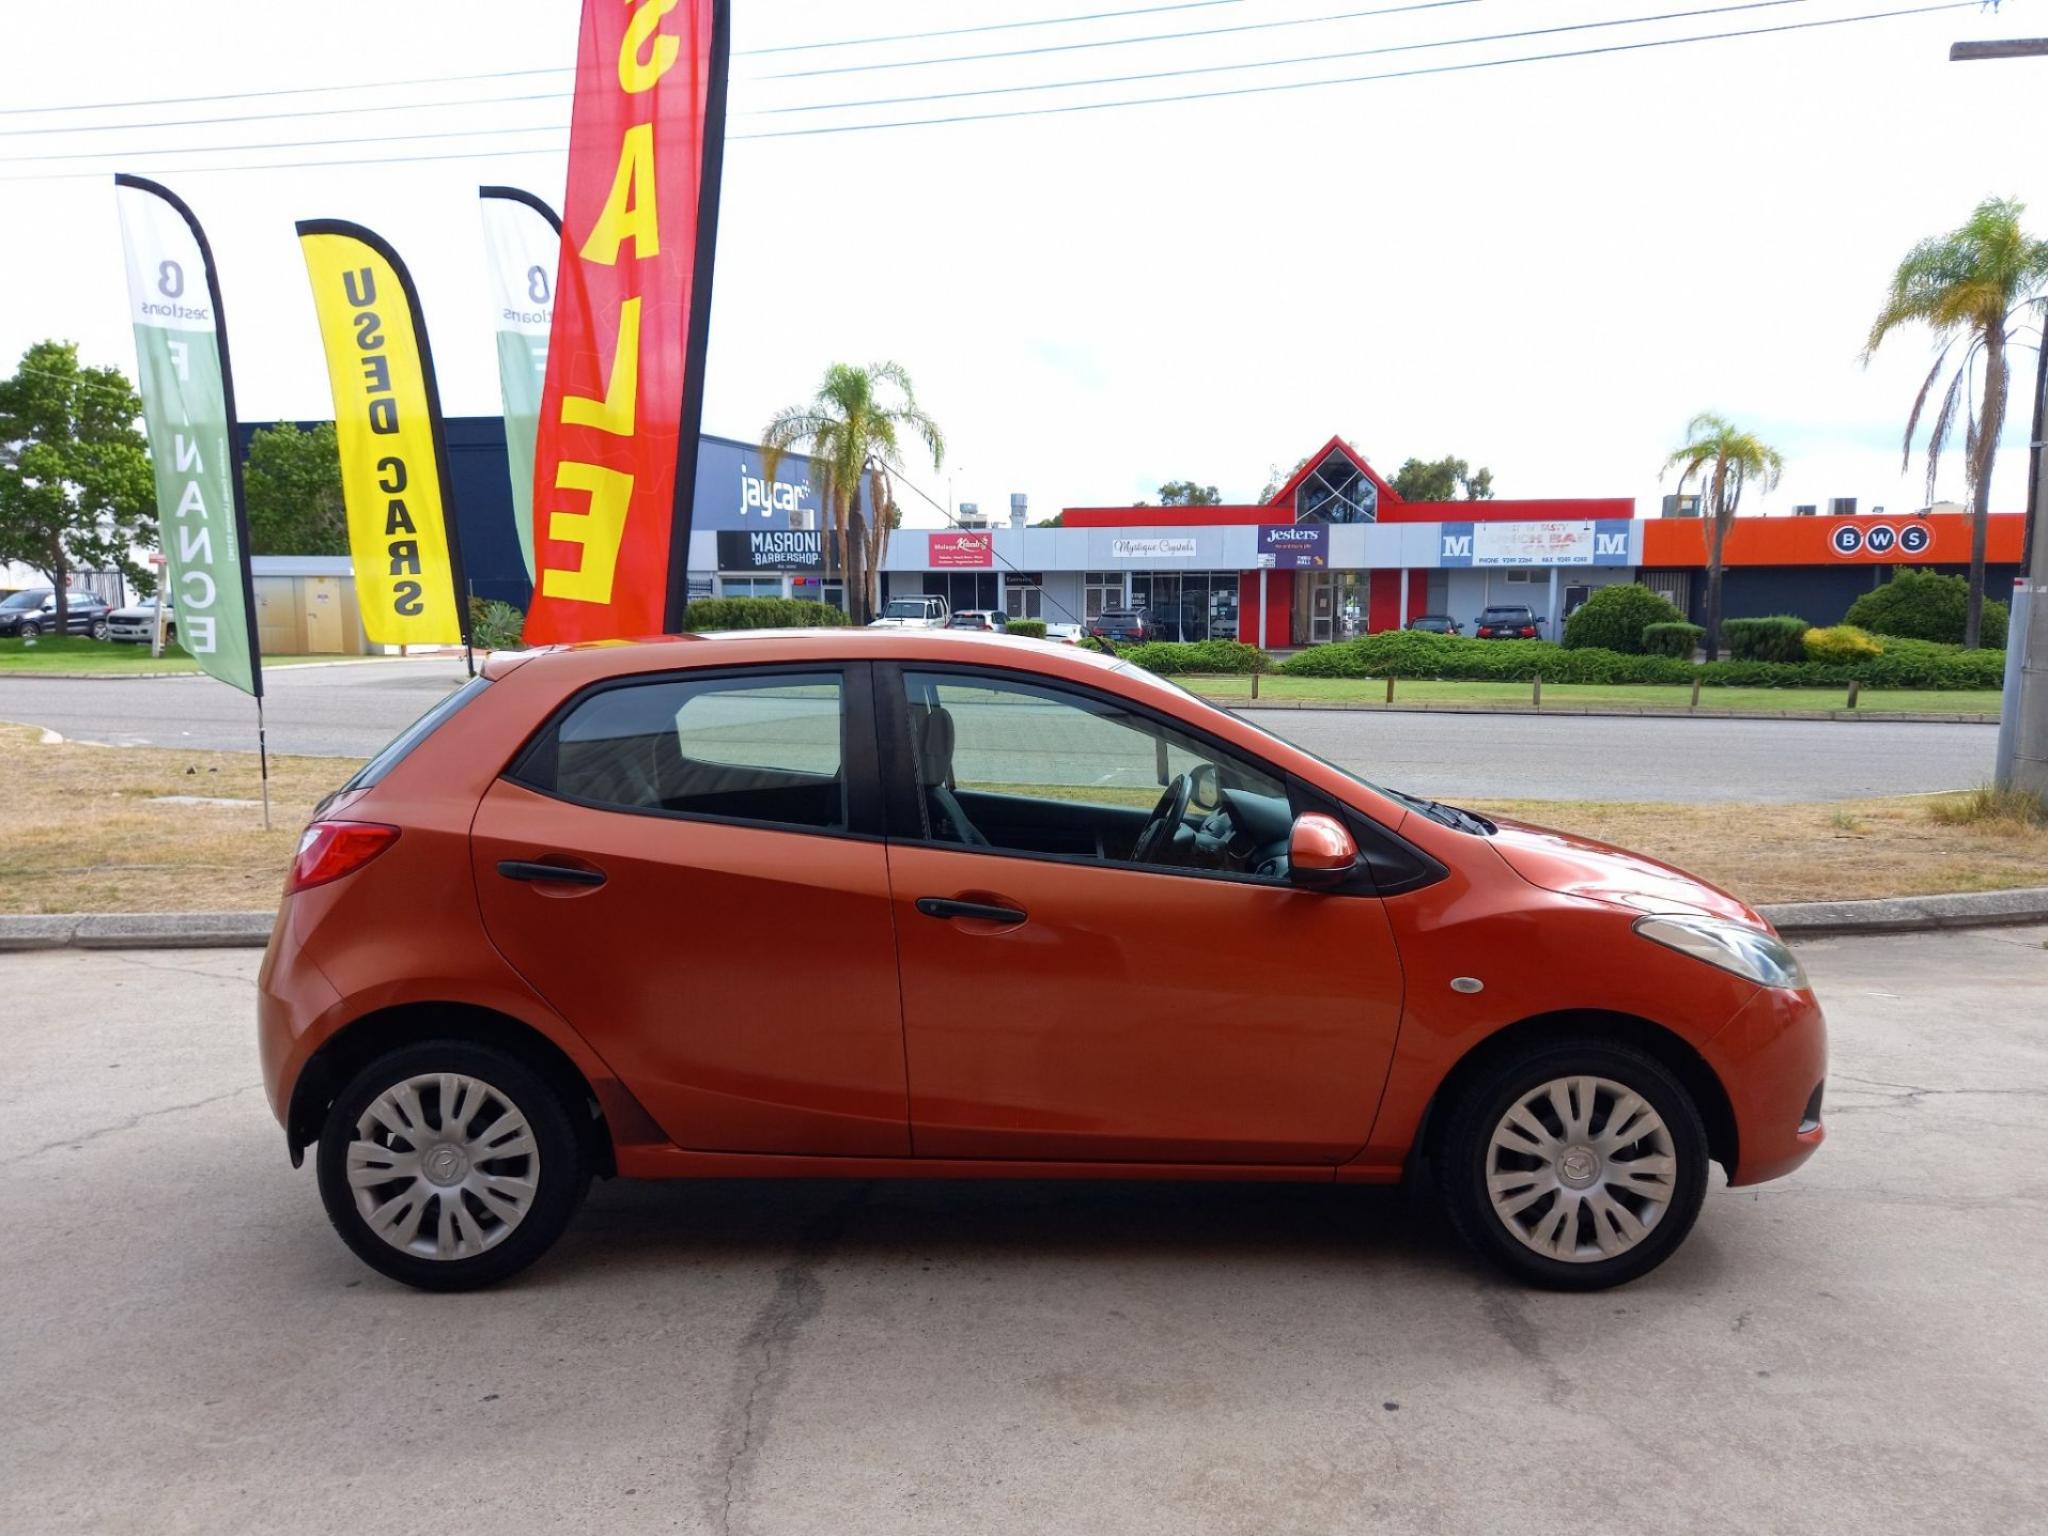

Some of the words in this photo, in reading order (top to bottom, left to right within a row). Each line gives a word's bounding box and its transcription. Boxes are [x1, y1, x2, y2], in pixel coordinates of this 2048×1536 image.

[740, 464, 805, 518] jaycar
[750, 532, 822, 552] MASRONI
[1266, 528, 1320, 543] Jesters
[1442, 535, 1472, 557] M
[1595, 533, 1627, 555] M
[1842, 532, 1921, 547] BWS
